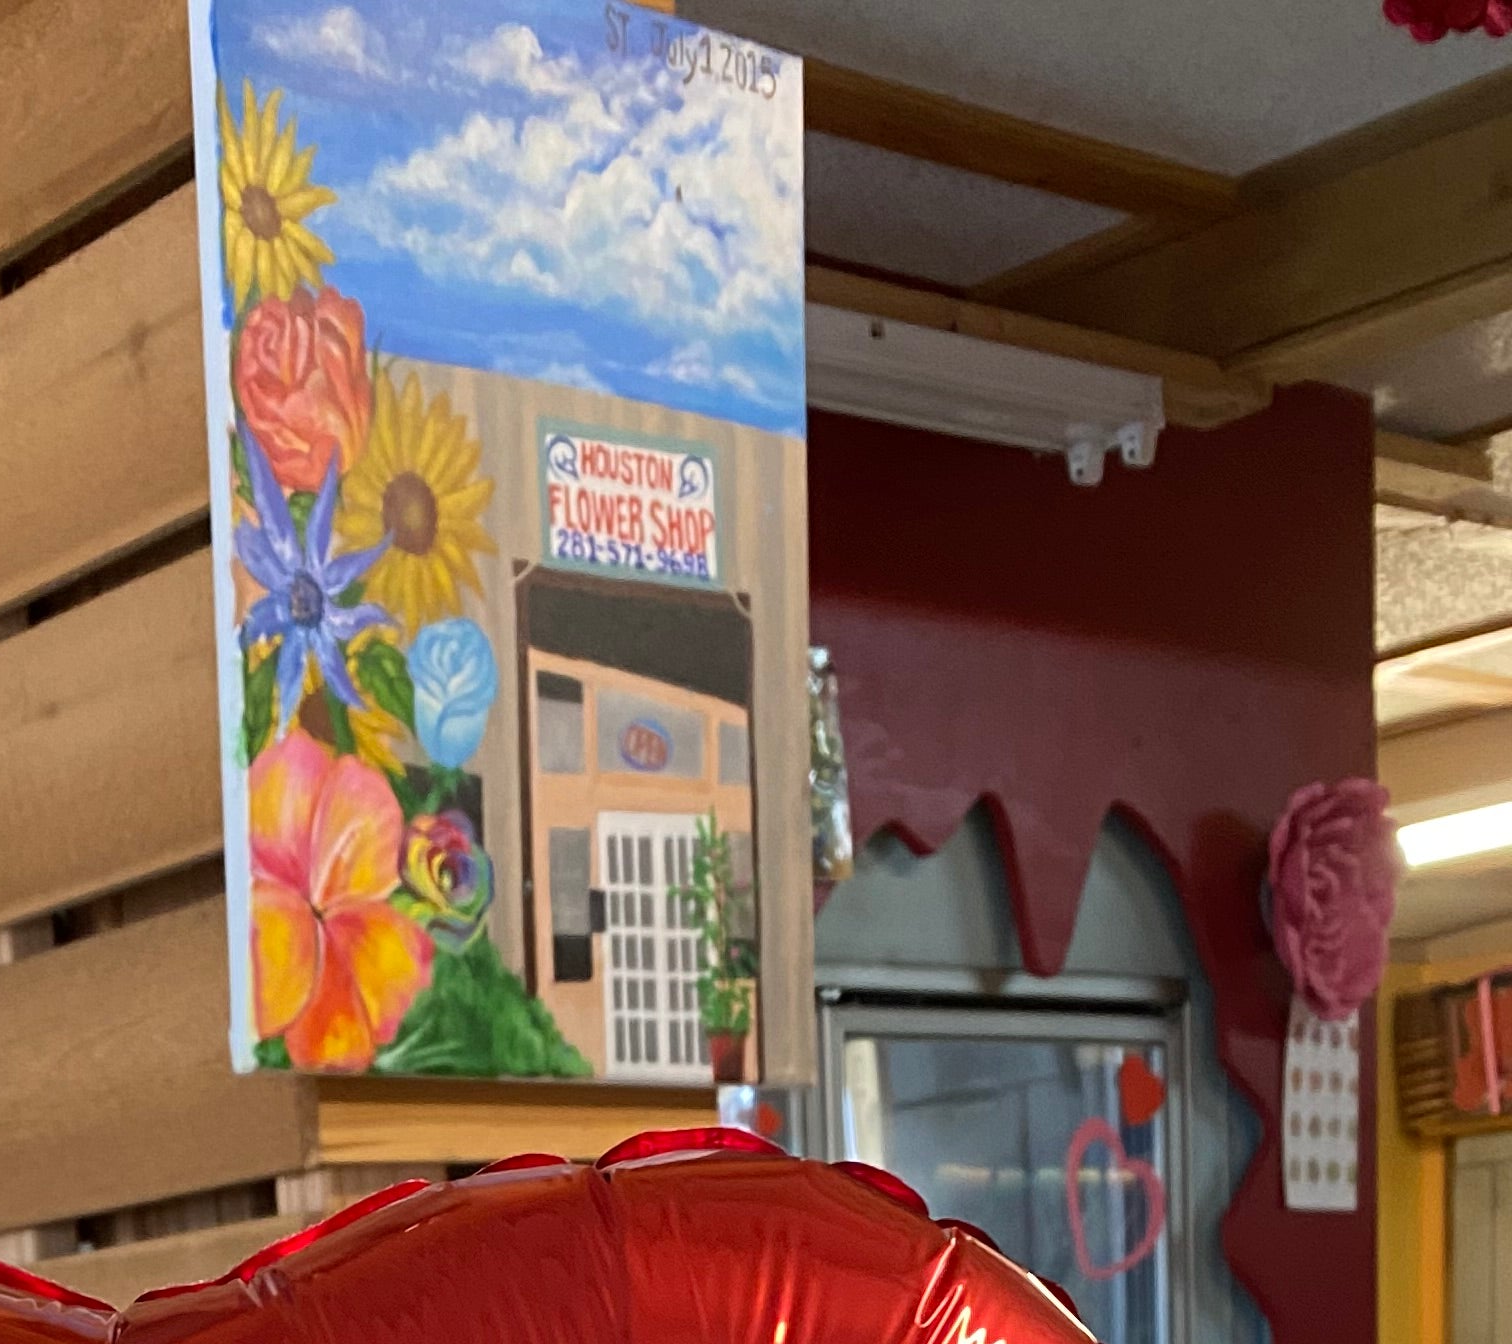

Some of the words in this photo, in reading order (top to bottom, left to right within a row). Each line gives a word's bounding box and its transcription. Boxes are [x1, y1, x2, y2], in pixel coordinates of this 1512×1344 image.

[580, 441, 673, 492] HOUSTON
[548, 482, 645, 544] FLOWER
[649, 500, 716, 556] SHOP
